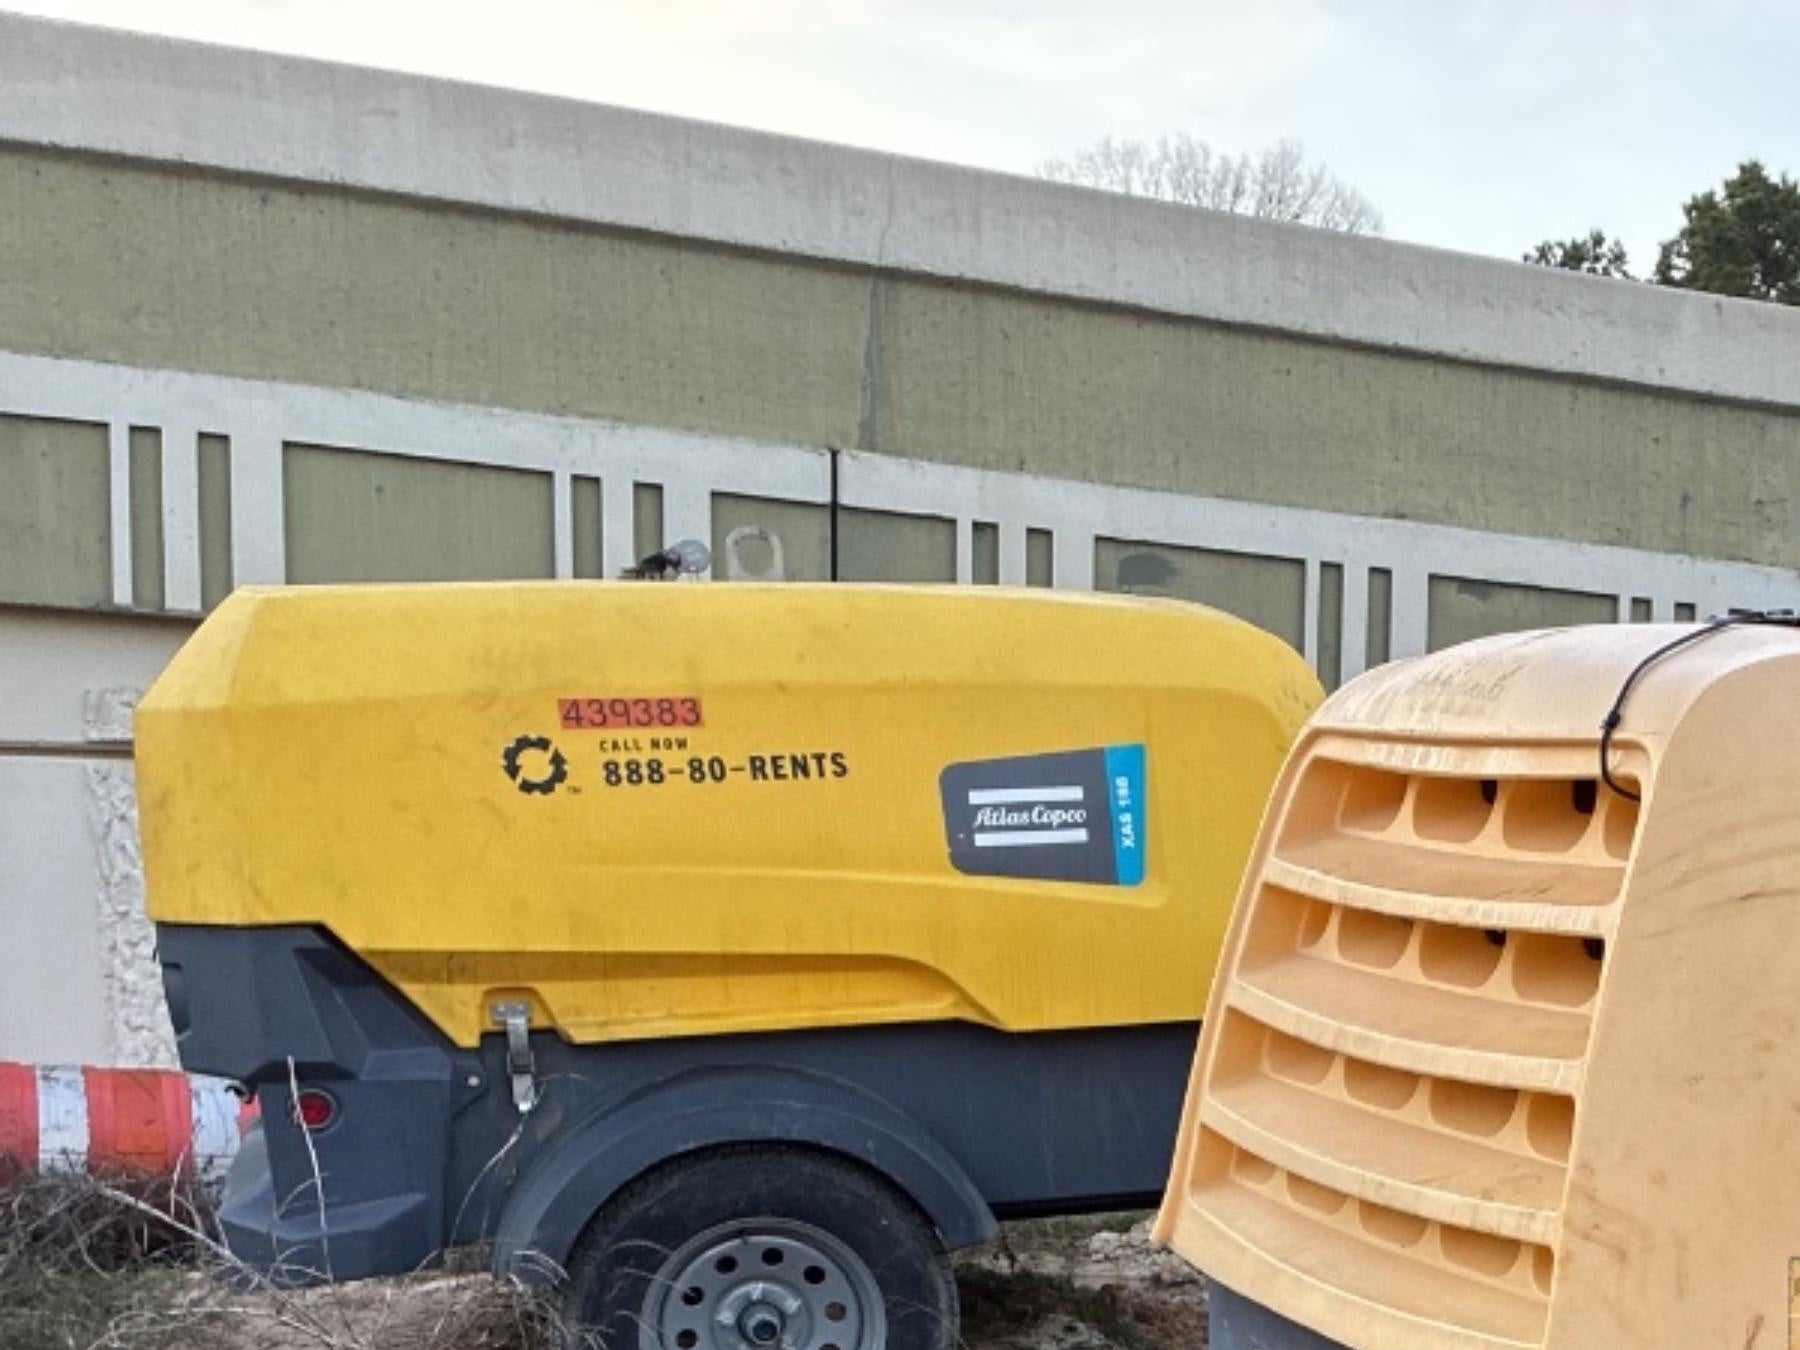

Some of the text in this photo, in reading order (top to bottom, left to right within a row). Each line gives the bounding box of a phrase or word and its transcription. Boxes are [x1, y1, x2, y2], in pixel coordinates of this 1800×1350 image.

[562, 698, 701, 727] 439383
[600, 736, 689, 753] CALL NOW
[602, 752, 849, 786] 888-80-RENTS
[972, 803, 1088, 829] Atlas Copco
[1117, 812, 1136, 850] XAS
